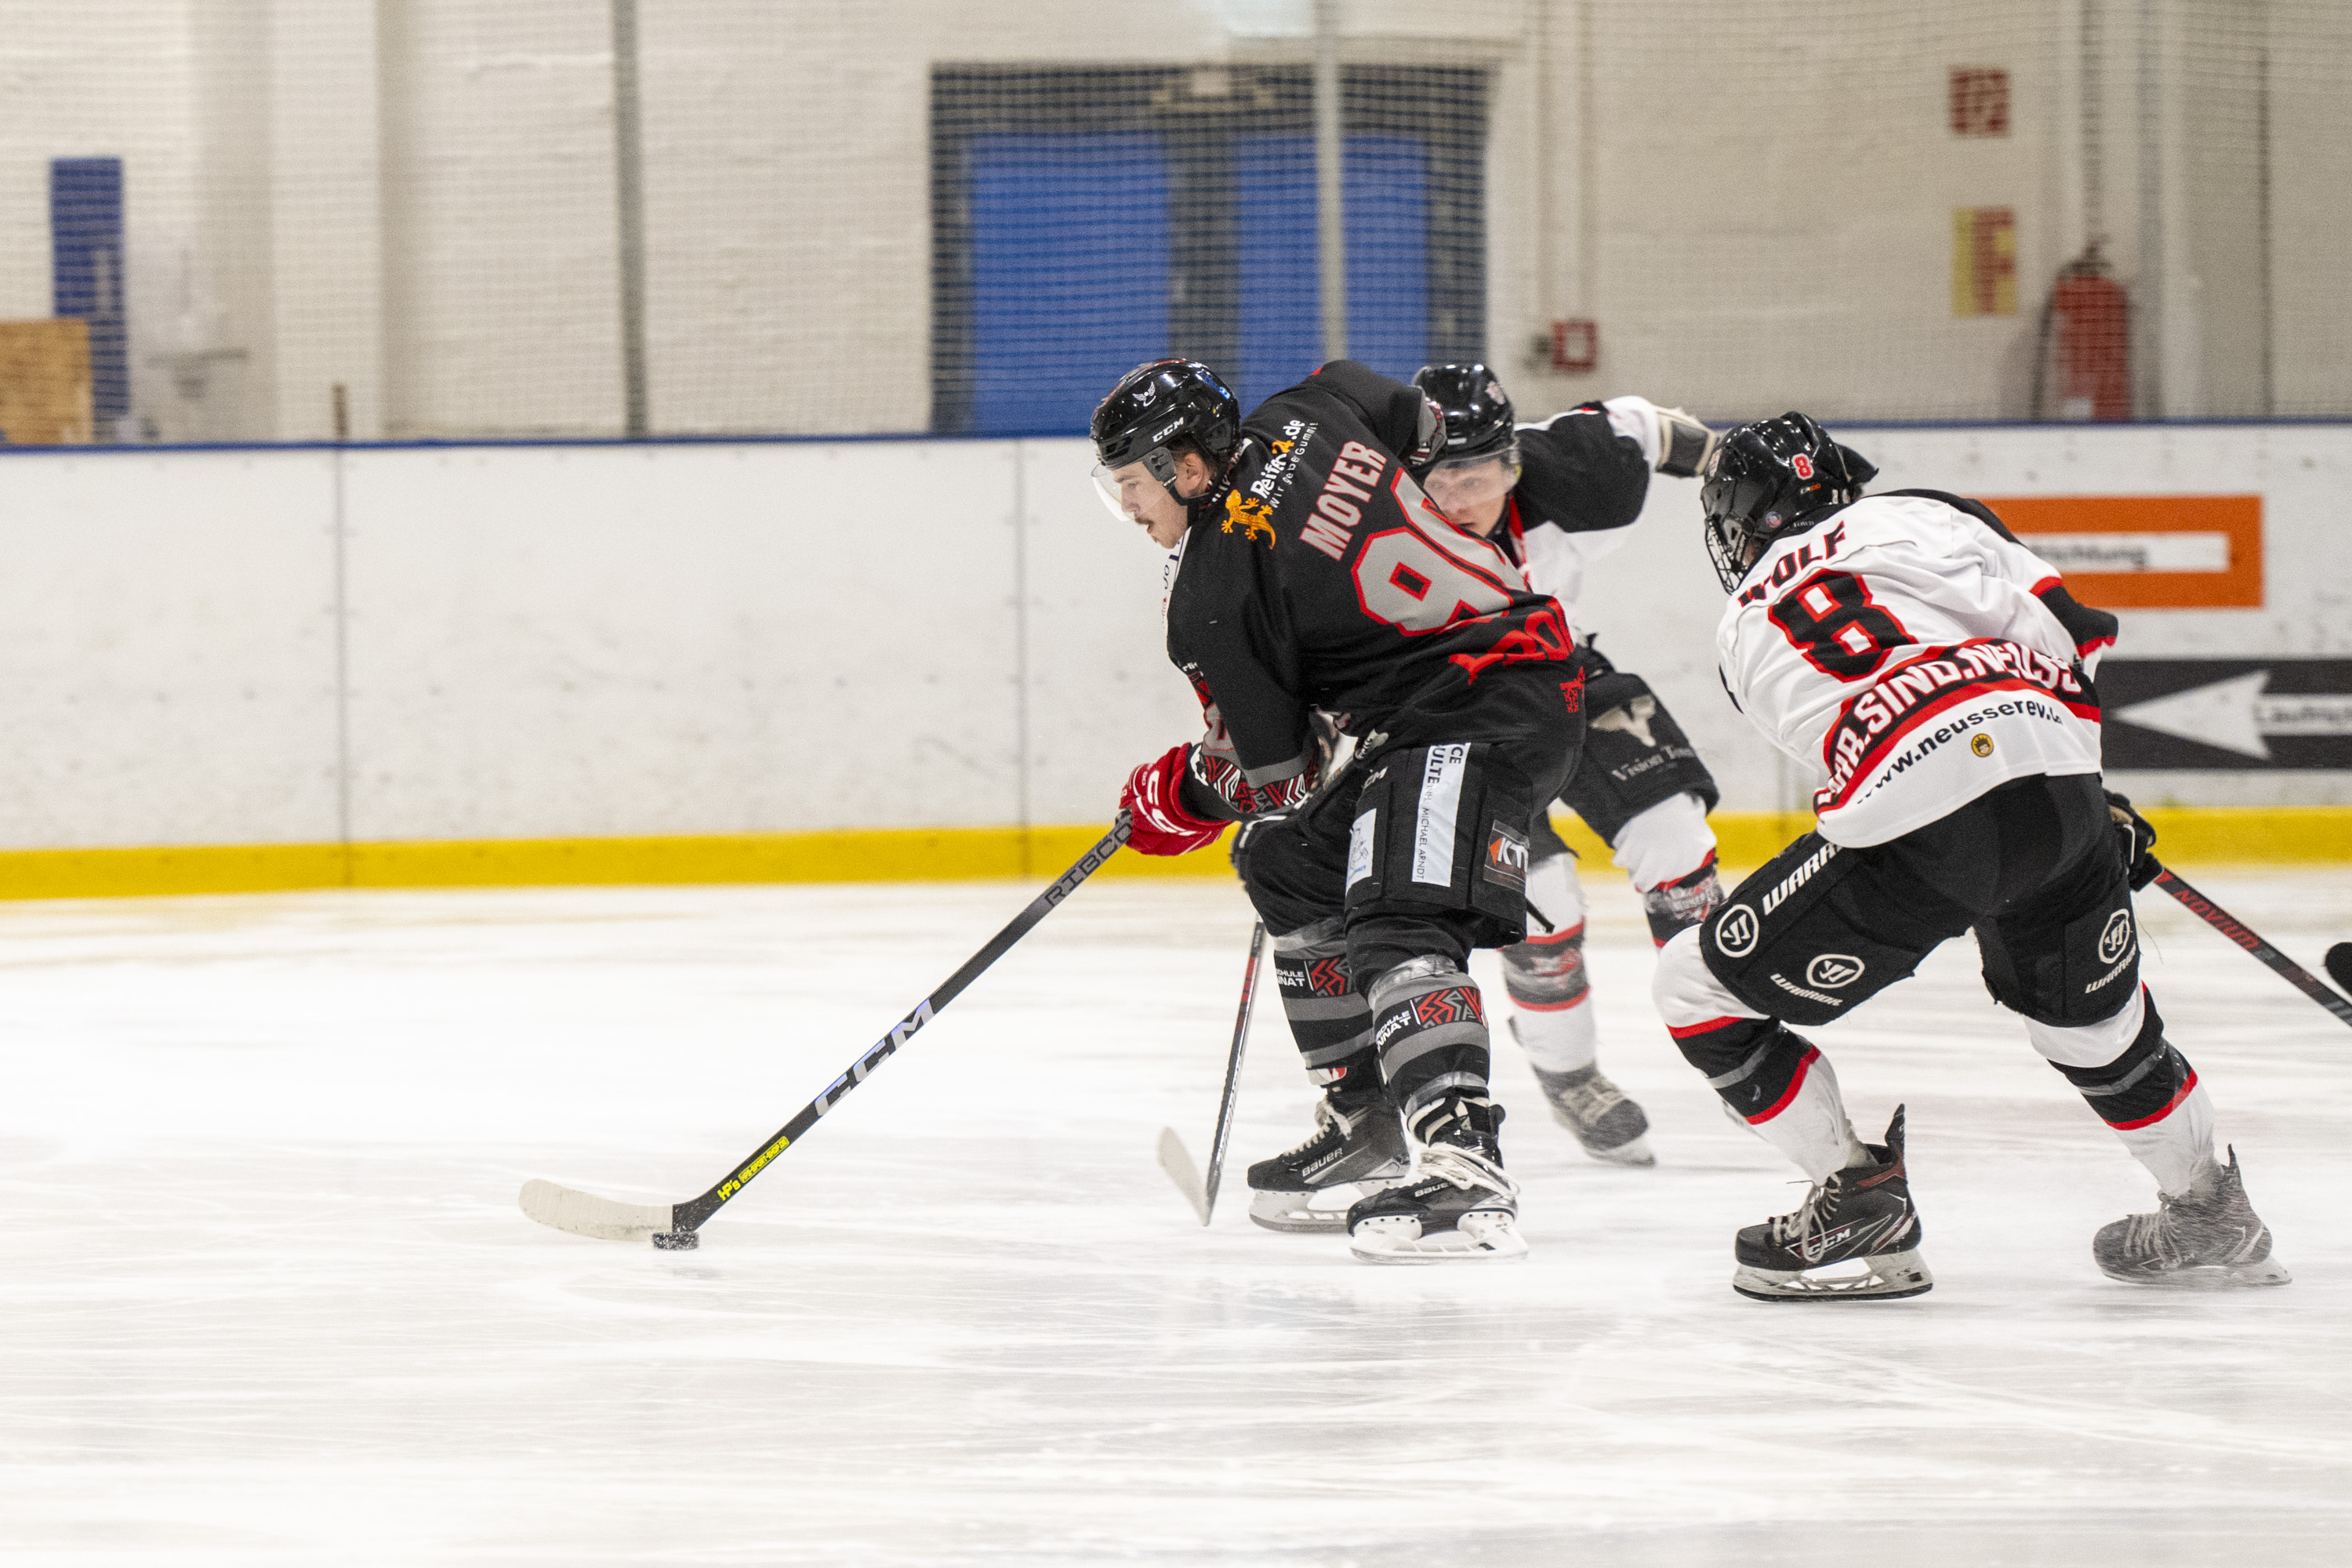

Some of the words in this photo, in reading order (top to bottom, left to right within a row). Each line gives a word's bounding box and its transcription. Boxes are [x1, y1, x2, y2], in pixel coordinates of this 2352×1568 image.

[1152, 416, 1184, 442] CCM
[1791, 453, 1814, 480] 8
[1299, 441, 1387, 561] MOYER
[1737, 520, 1846, 608] WOLF
[1767, 568, 1920, 683] 8
[1417, 807, 1430, 847] MICHAEL
[1414, 849, 1427, 880] ARNDT
[1770, 974, 1842, 1006] WARRIOR
[815, 998, 935, 1116] CCM
[1414, 1181, 1450, 1197] BAUE
[1809, 1229, 1851, 1255] CCM
